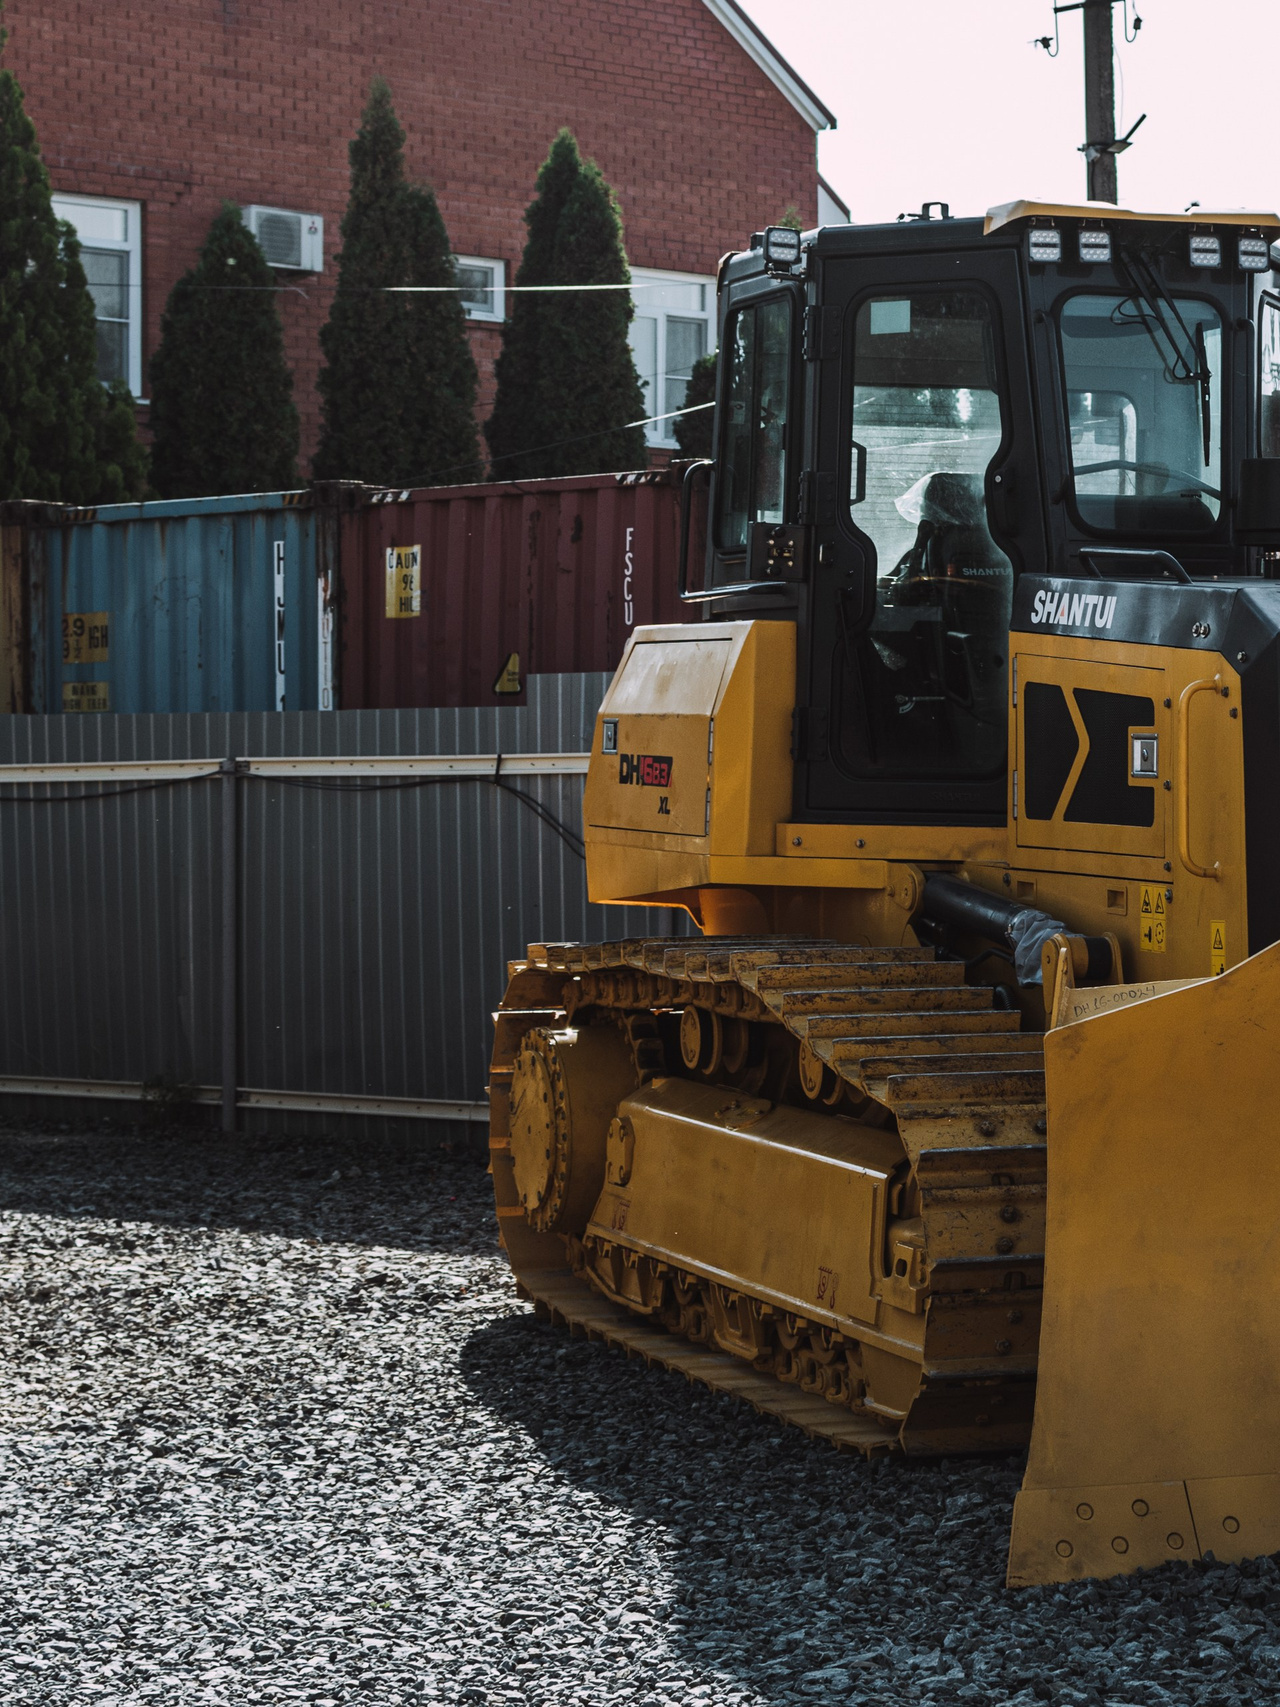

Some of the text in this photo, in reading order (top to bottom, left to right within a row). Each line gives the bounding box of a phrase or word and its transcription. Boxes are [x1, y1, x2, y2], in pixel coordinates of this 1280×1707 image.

[623, 527, 635, 626] FSCU
[1030, 589, 1118, 629] SHANTUI
[657, 795, 671, 816] XL
